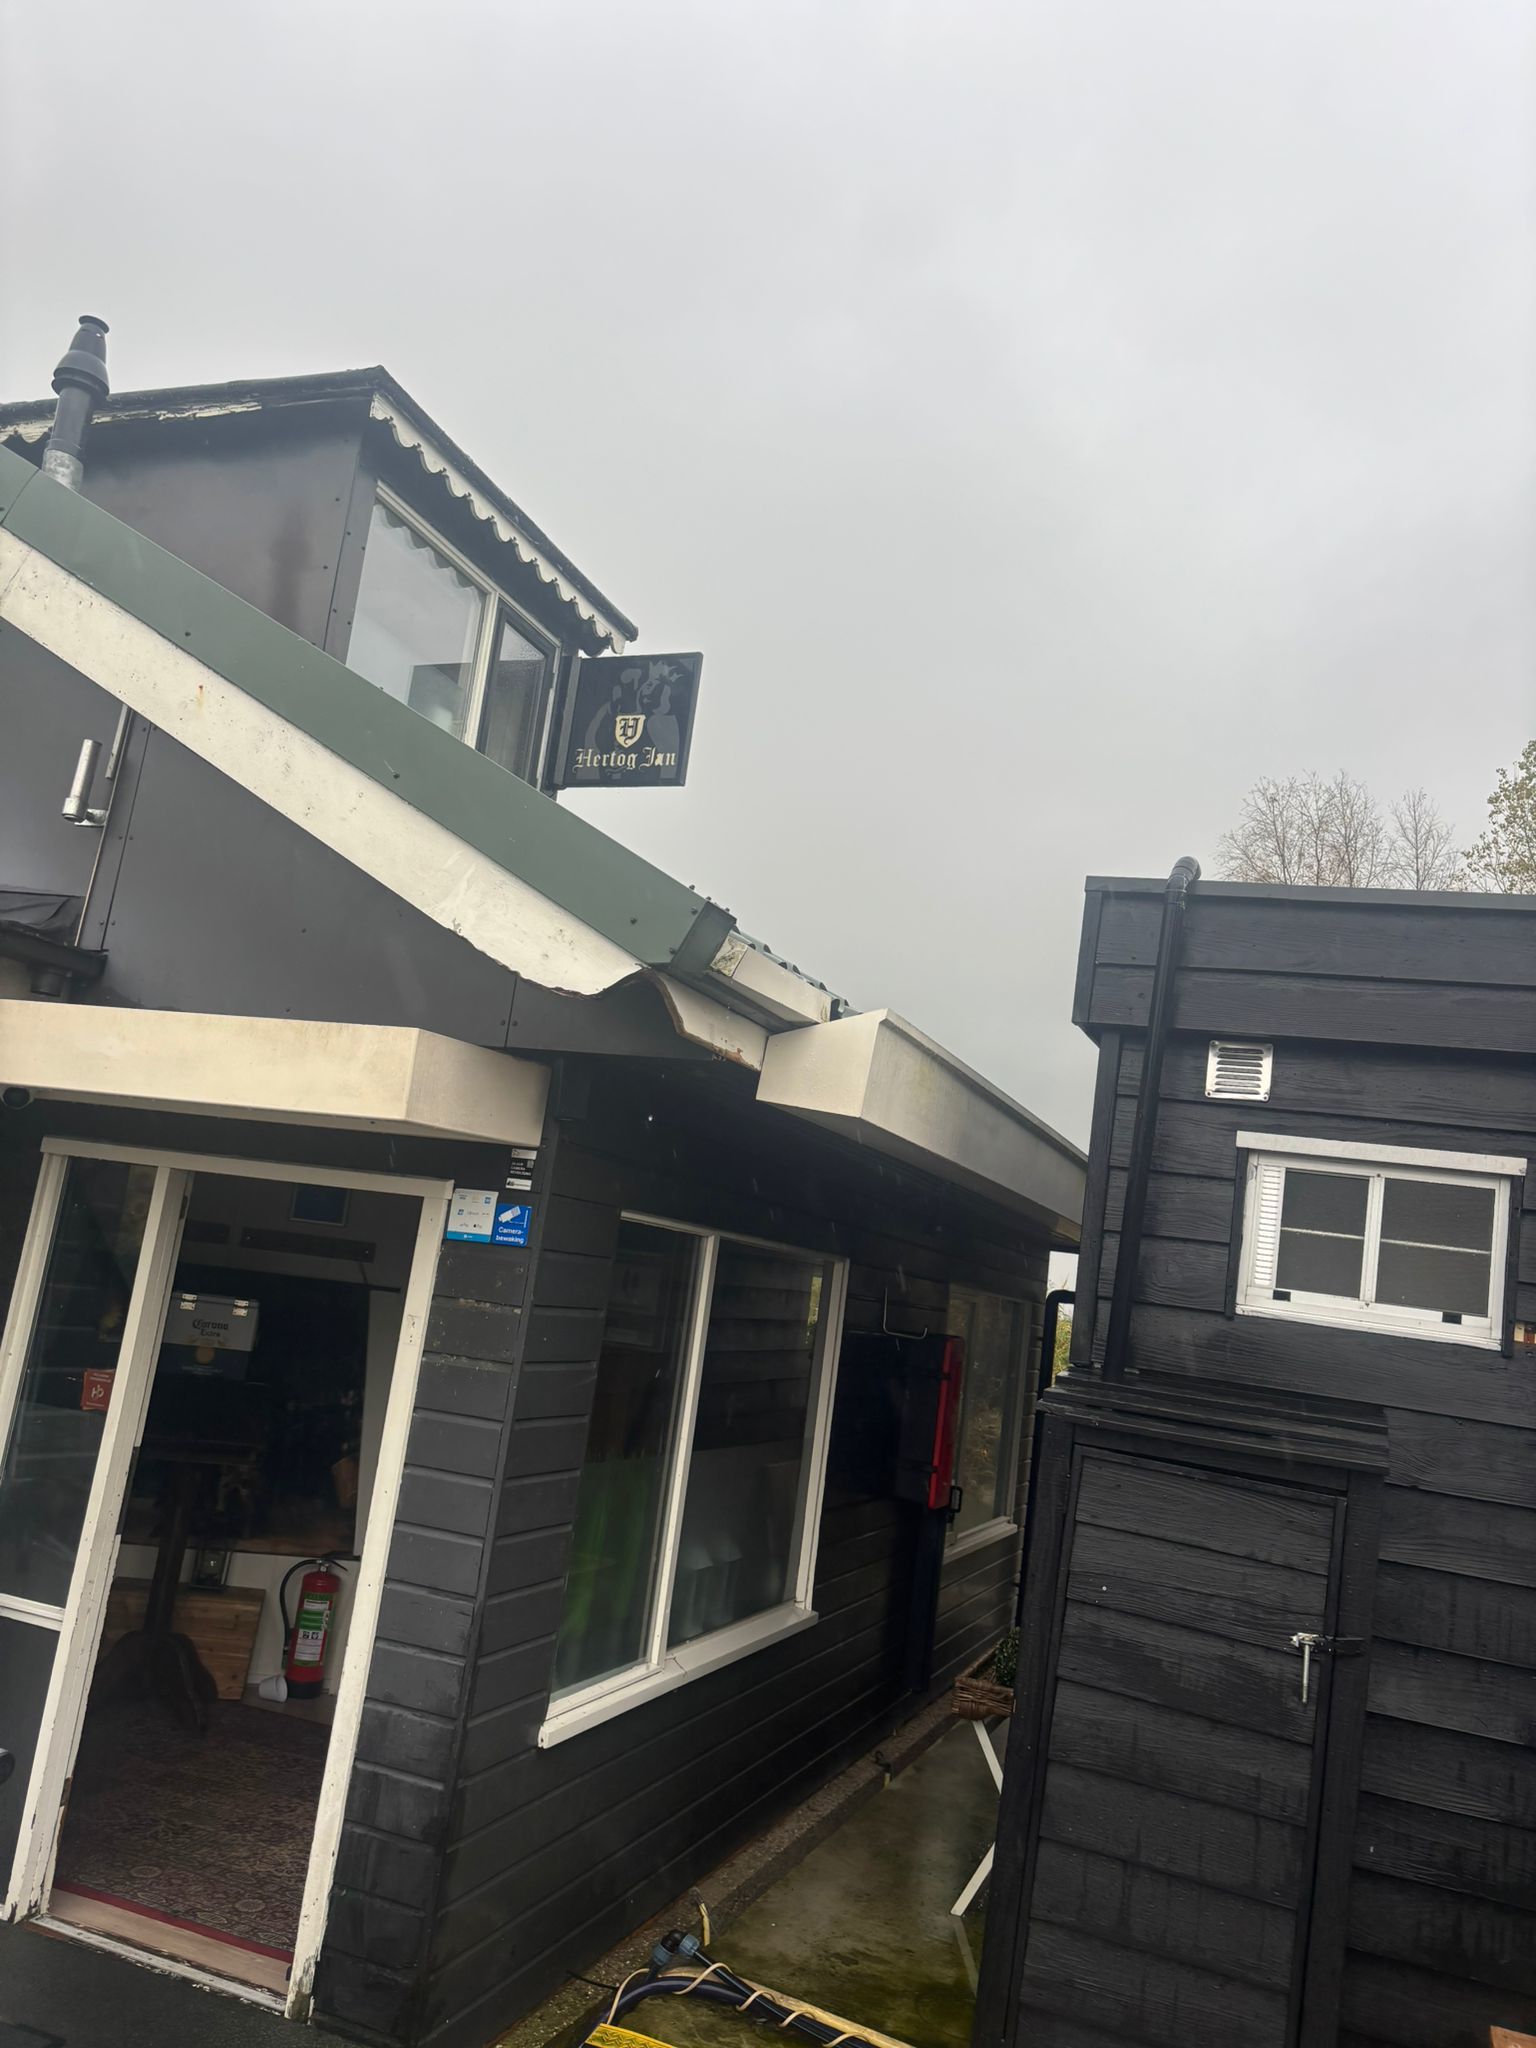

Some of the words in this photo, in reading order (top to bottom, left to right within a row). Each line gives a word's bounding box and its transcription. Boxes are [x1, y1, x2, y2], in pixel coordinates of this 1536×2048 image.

[572, 748, 639, 773] Hertog
[639, 746, 676, 771] Jan
[498, 1226, 524, 1235] Camera-
[495, 1234, 525, 1245] bewaking
[192, 1319, 229, 1331] Corona
